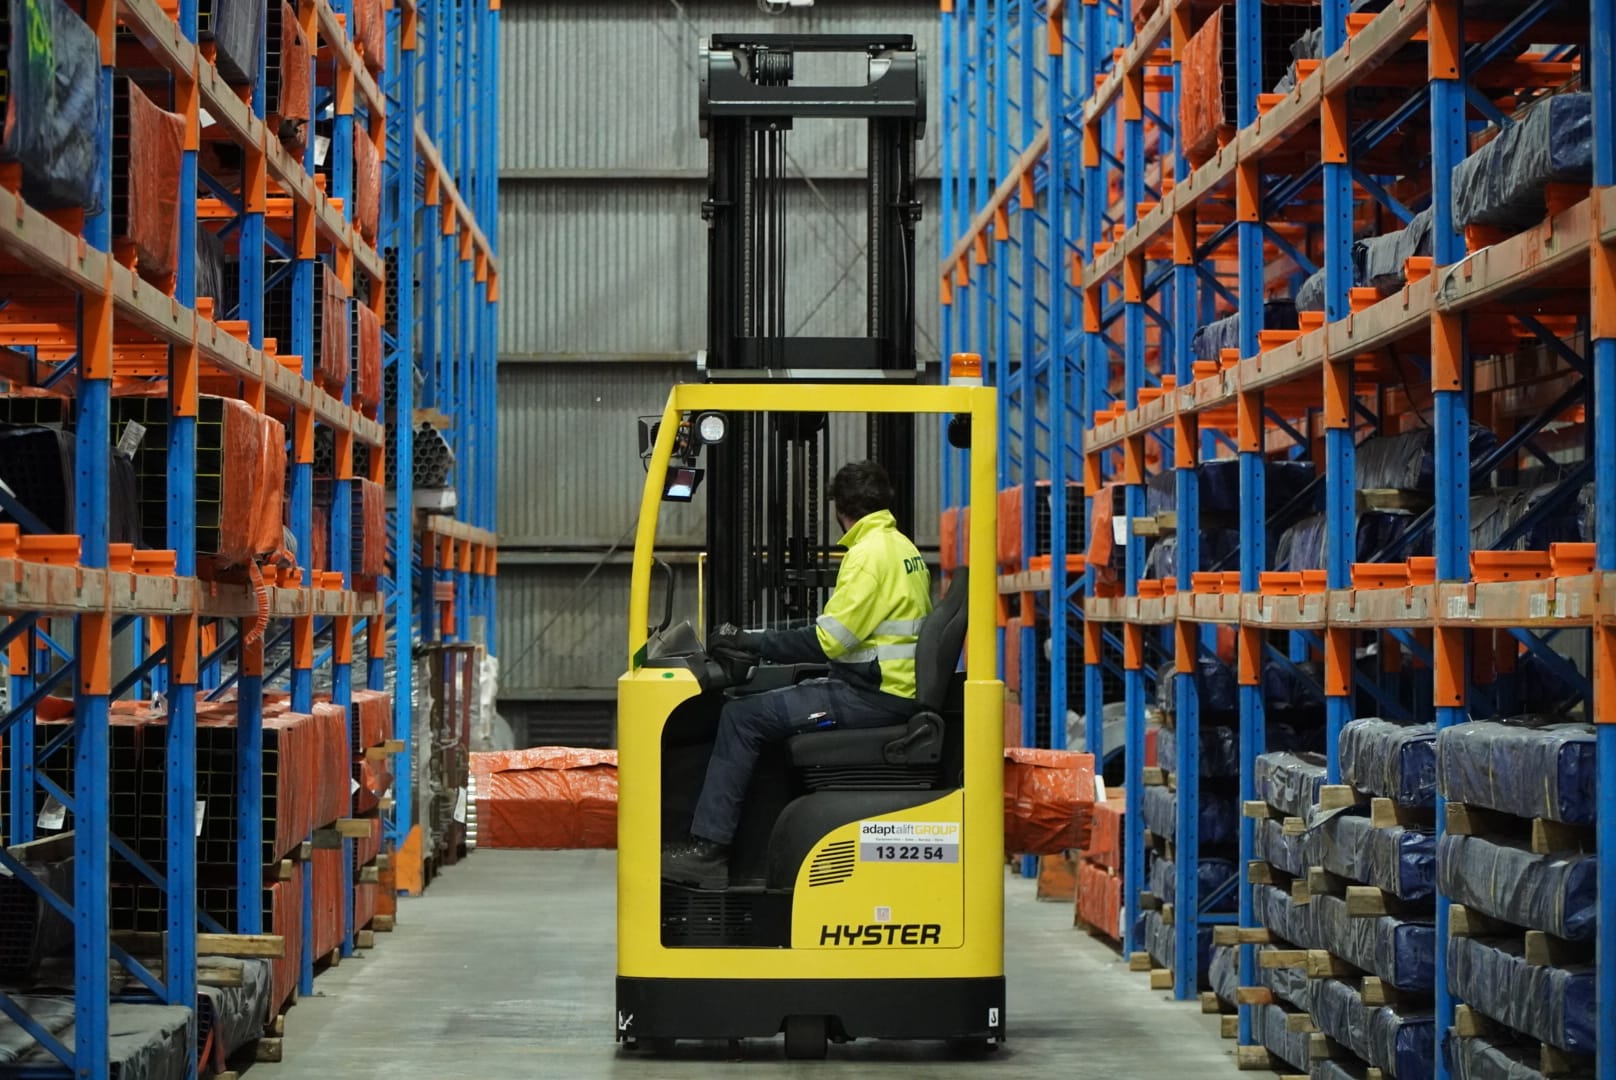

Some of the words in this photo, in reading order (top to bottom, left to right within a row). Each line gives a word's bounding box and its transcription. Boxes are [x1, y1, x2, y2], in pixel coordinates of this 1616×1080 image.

[876, 846, 895, 859] 13
[899, 846, 919, 860] 22
[924, 846, 943, 860] 54
[820, 924, 942, 946] HYSTER
